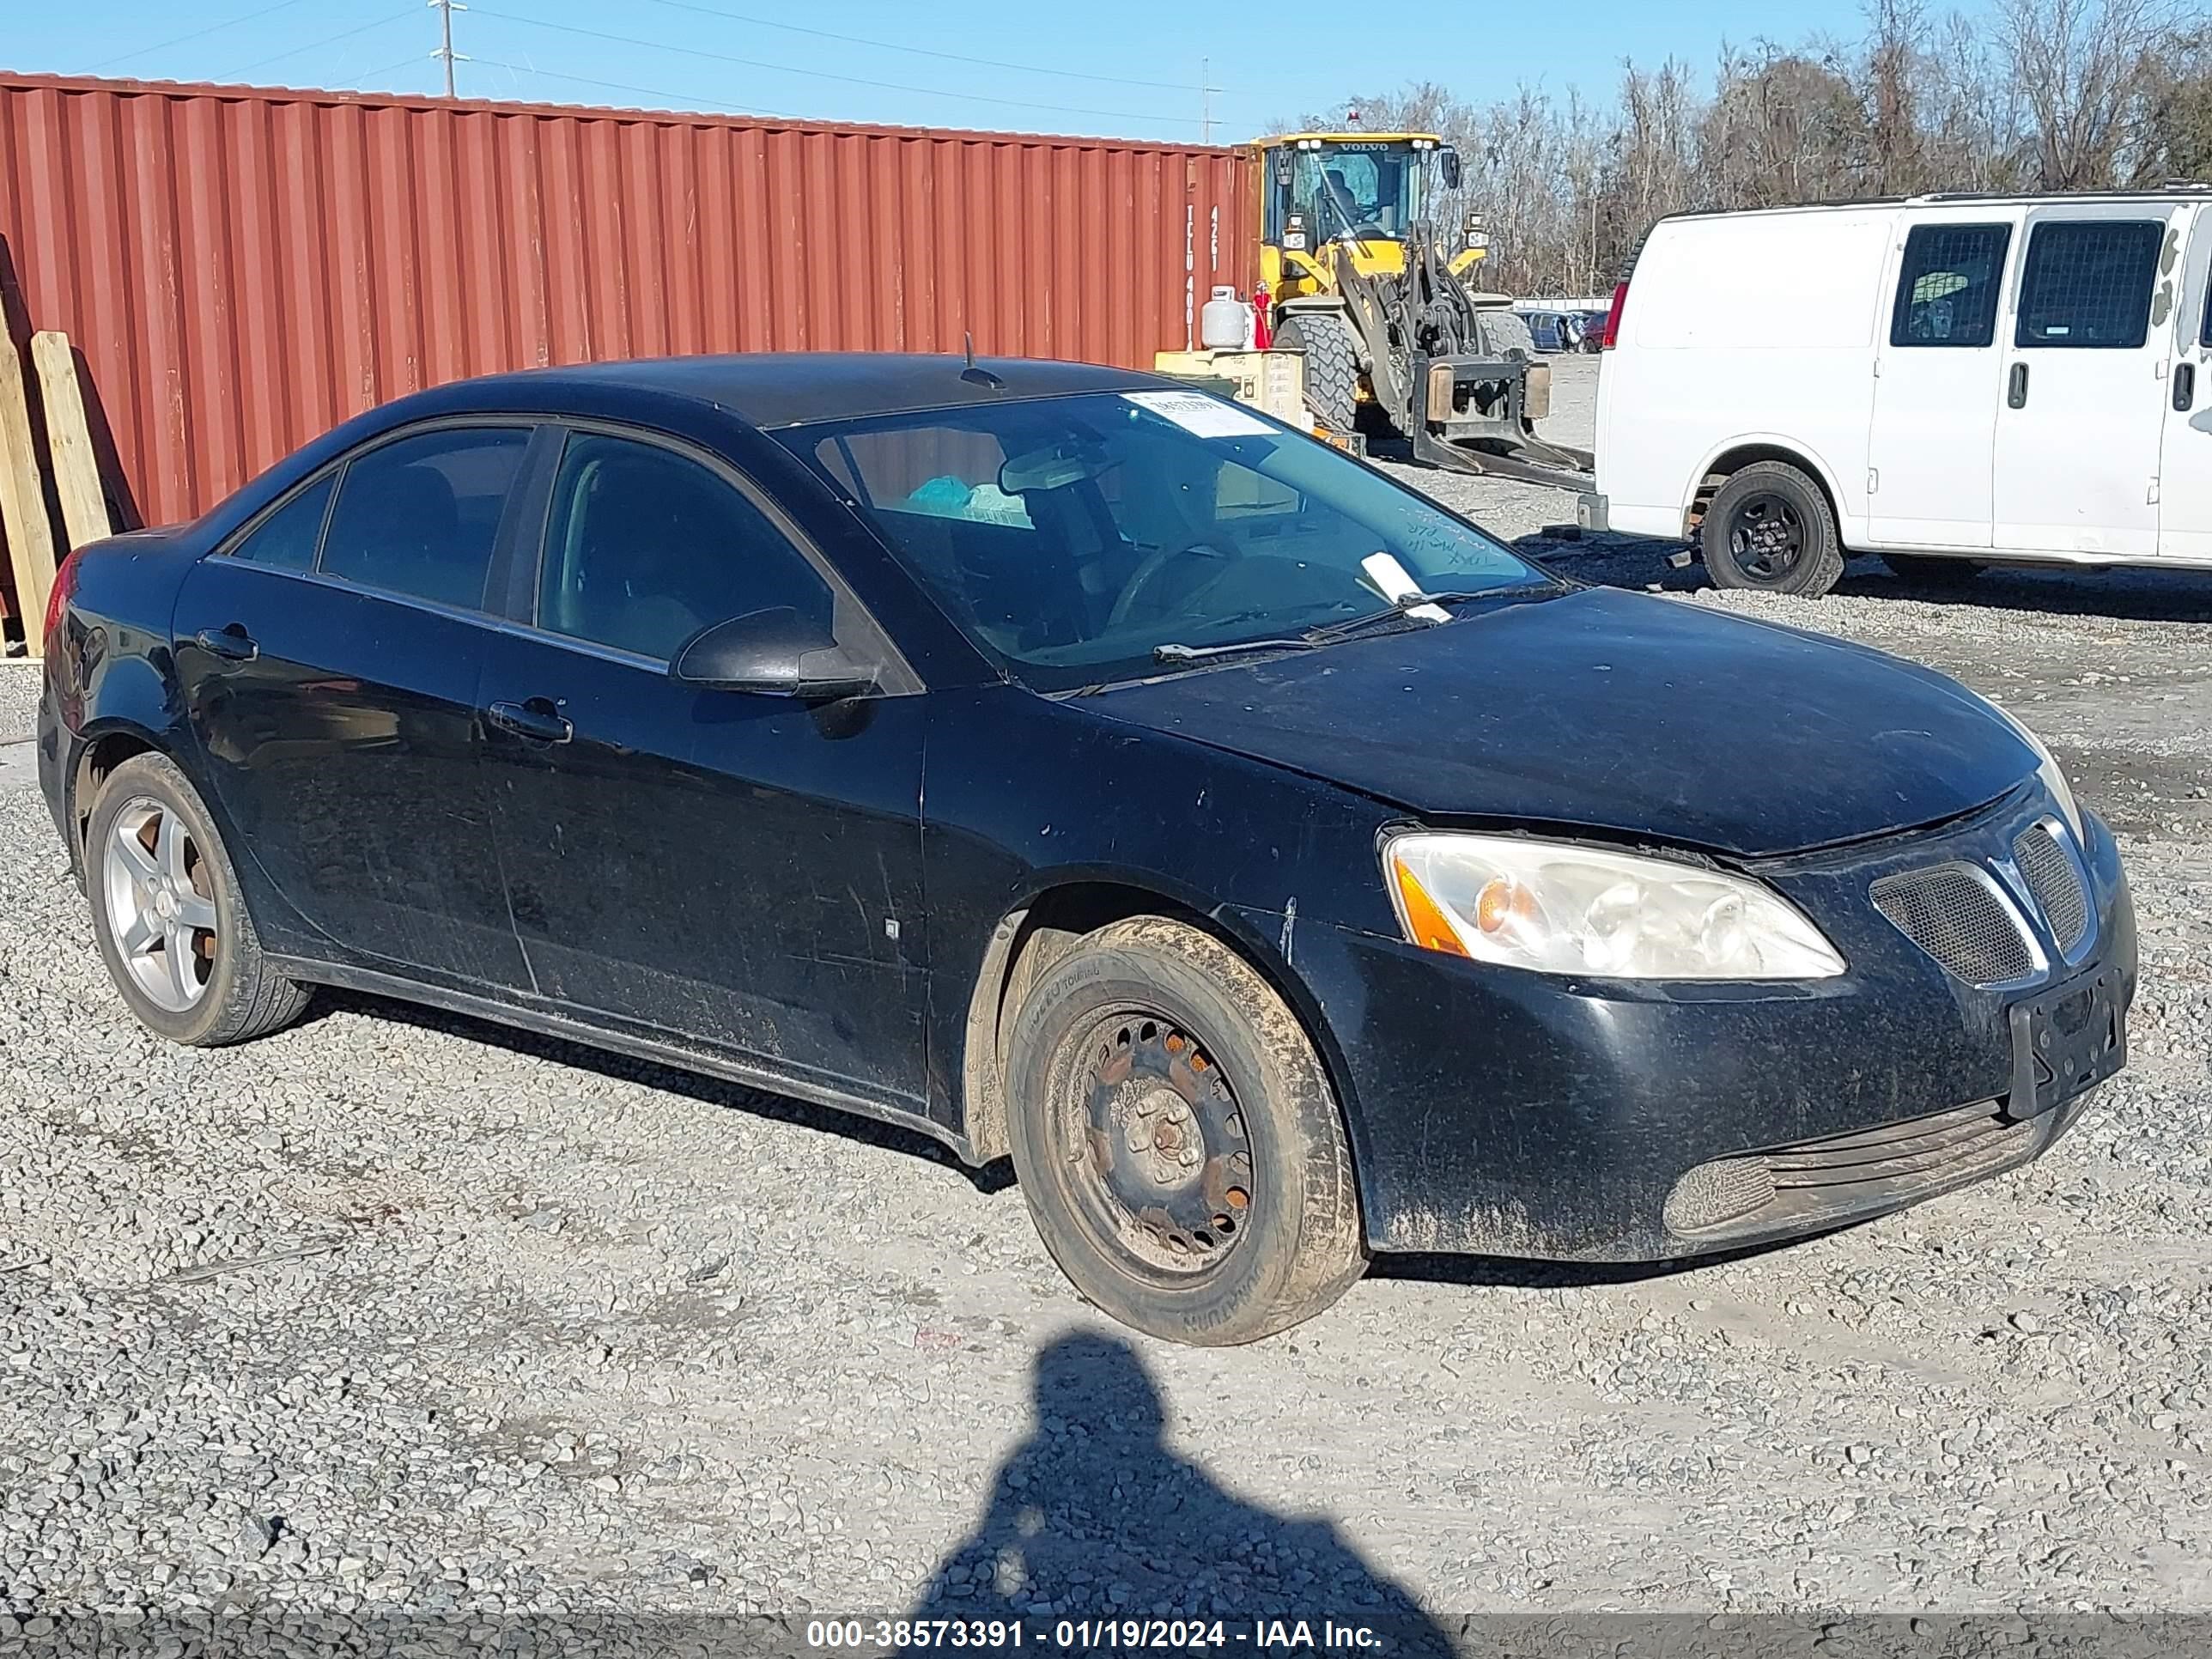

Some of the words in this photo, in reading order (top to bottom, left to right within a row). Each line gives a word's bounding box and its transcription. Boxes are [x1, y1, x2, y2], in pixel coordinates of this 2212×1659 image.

[1339, 143, 1389, 151] VOLVO
[1186, 205, 1194, 271] TCLU
[1062, 968, 1100, 990] TOURING
